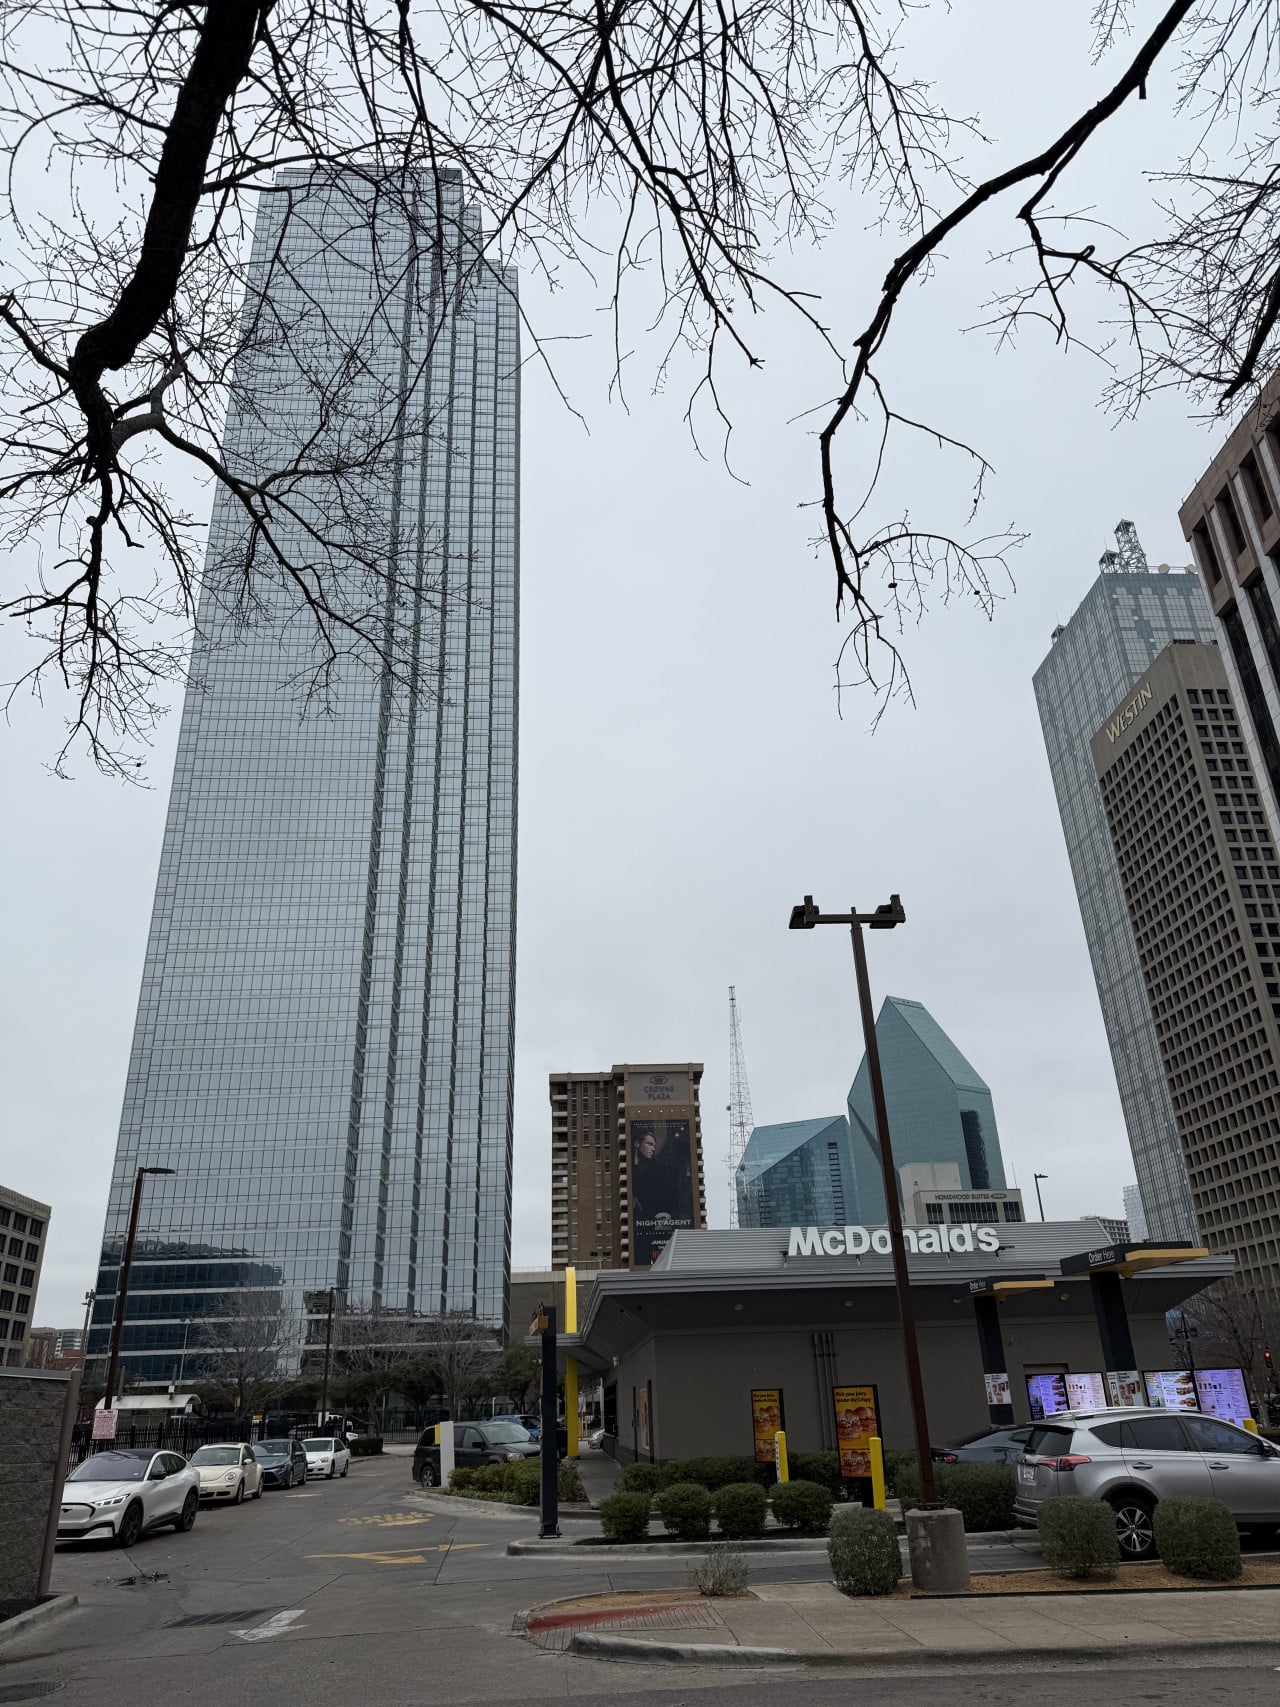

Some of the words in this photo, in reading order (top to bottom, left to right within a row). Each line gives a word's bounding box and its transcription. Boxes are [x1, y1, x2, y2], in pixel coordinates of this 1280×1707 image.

[1105, 682, 1153, 743] WESTIN
[644, 1085, 674, 1093] CROWNE
[788, 1223, 1000, 1256] McDonald's
[1088, 1251, 1103, 1263] Order
[1102, 1249, 1115, 1261] Here
